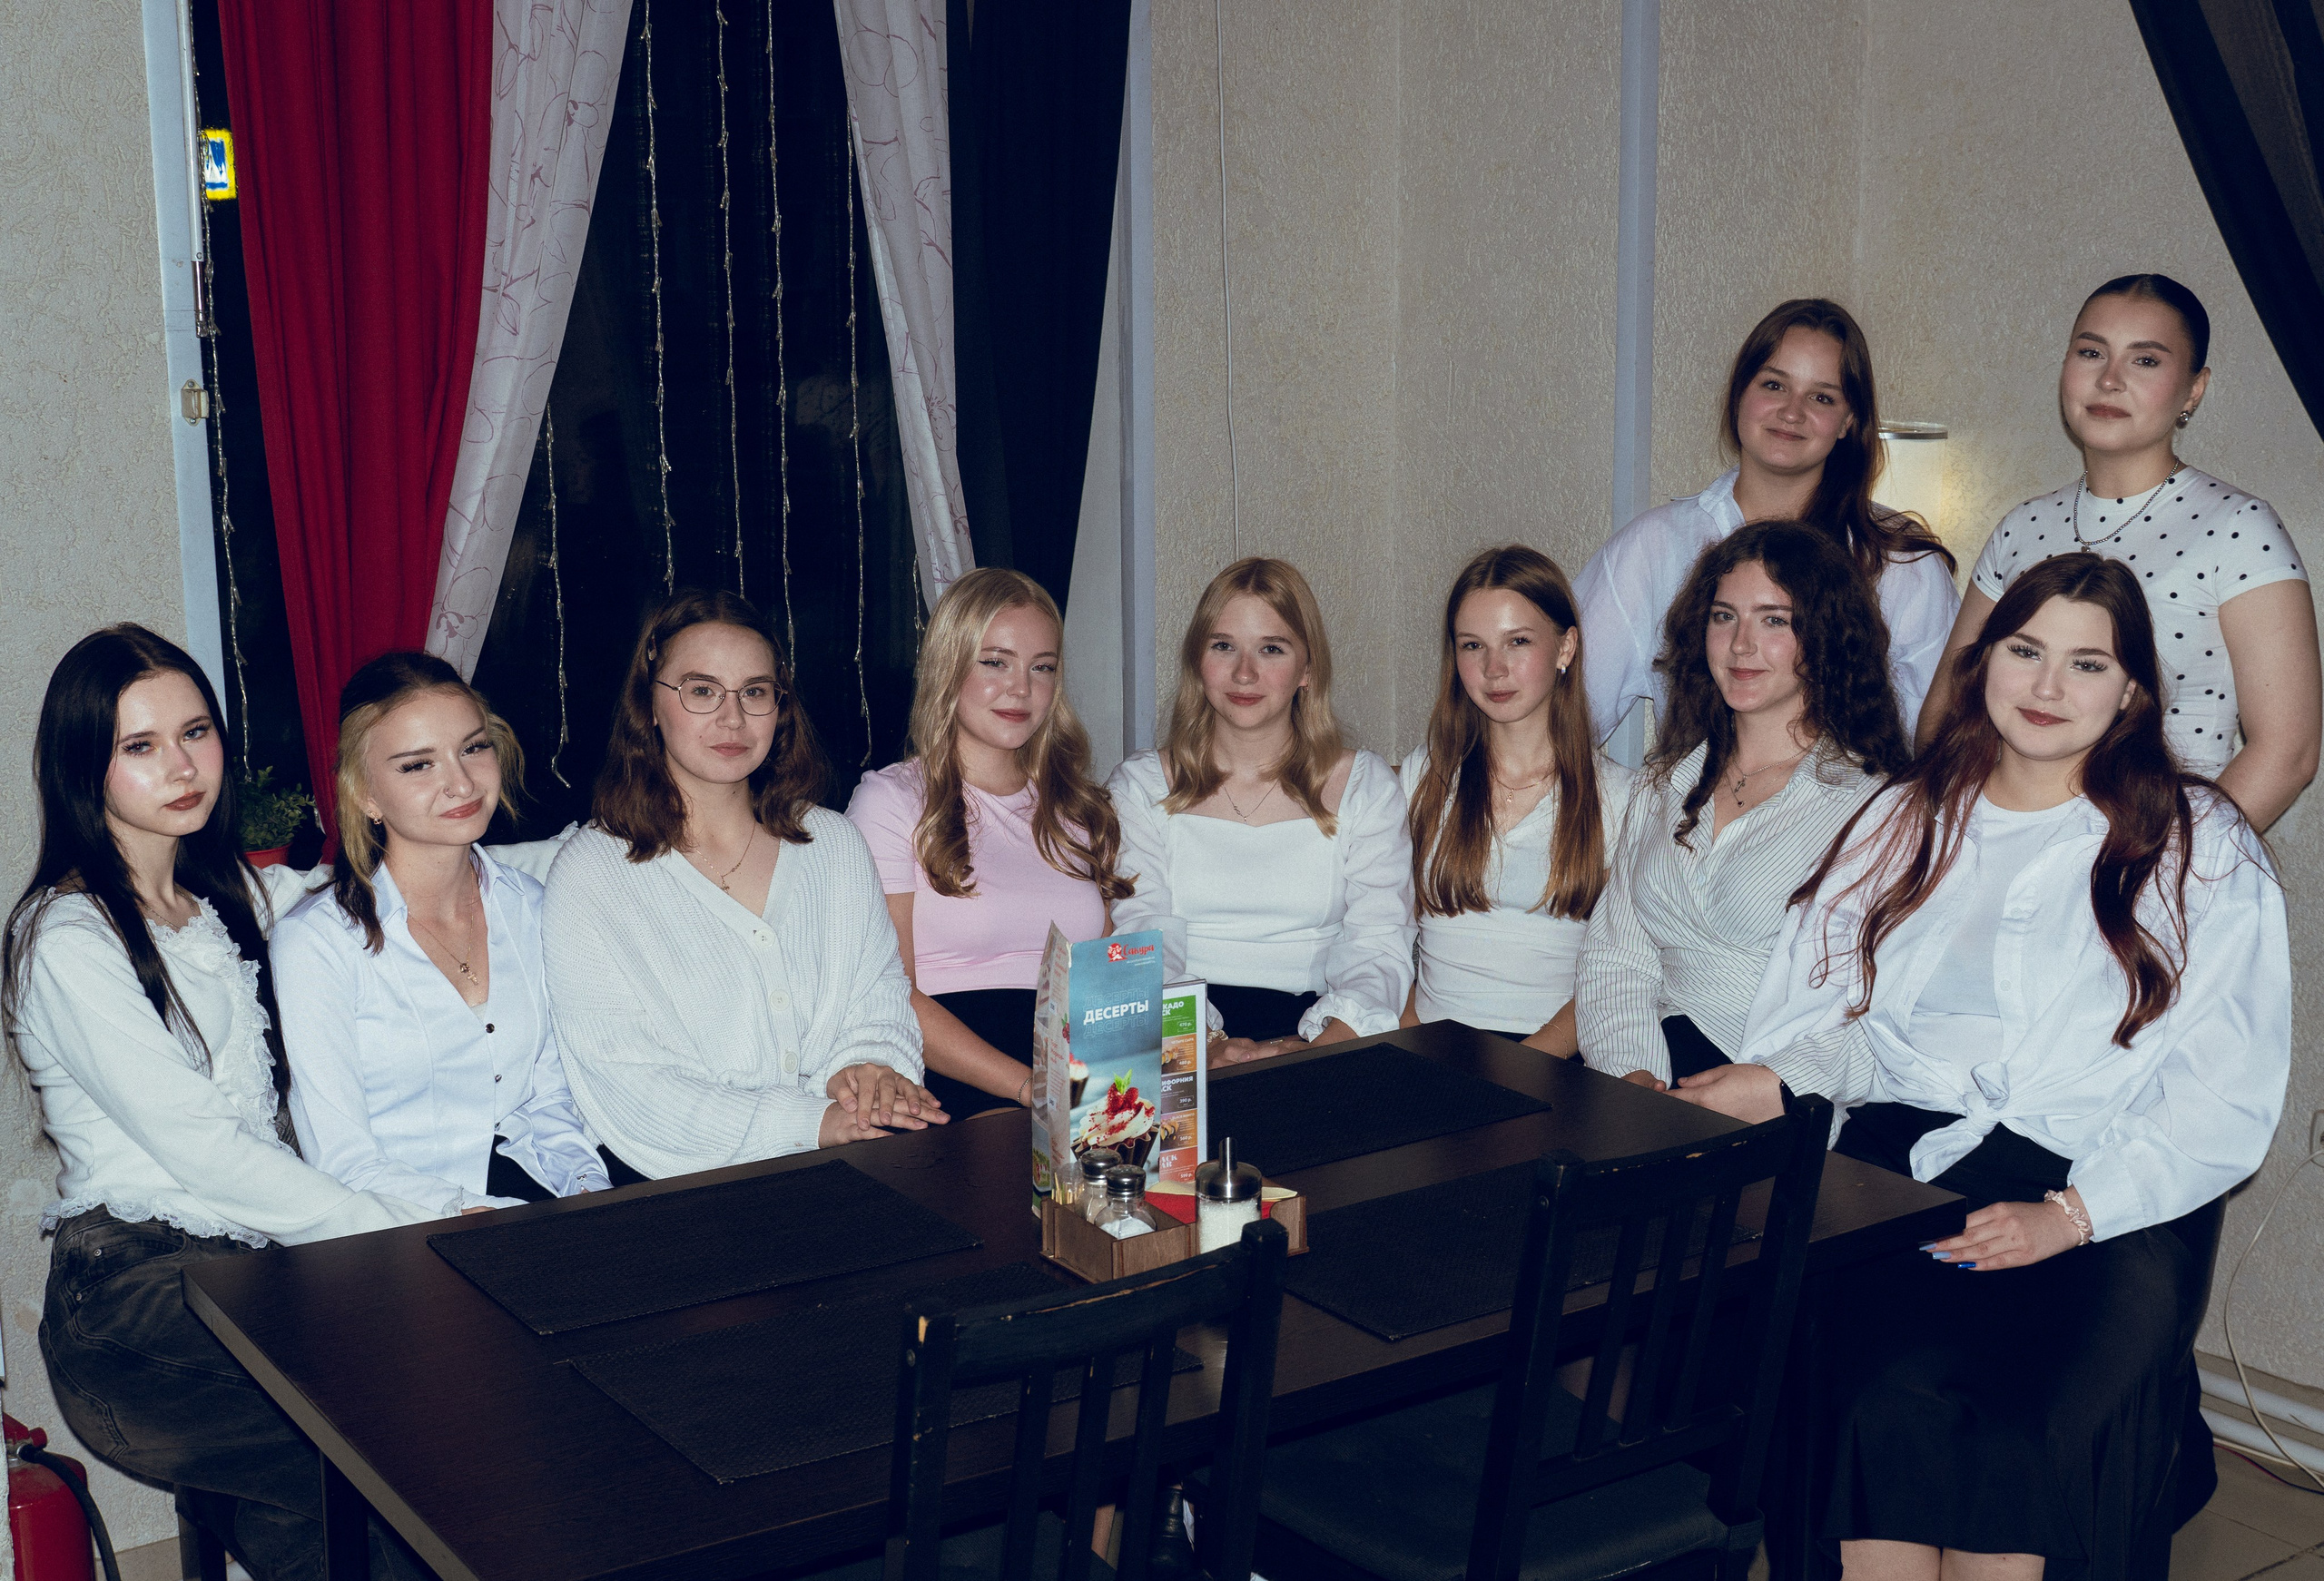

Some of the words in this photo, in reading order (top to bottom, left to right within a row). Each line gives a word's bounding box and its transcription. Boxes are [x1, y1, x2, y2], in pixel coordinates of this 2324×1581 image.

[1123, 944, 1155, 956] Сакура
[1162, 1001, 1184, 1010] КАДО
[1083, 999, 1148, 1026] ДЕСЕРТЫ
[1161, 1075, 1194, 1086] ИФОРНИЯ
[1161, 1154, 1177, 1163] ACK
